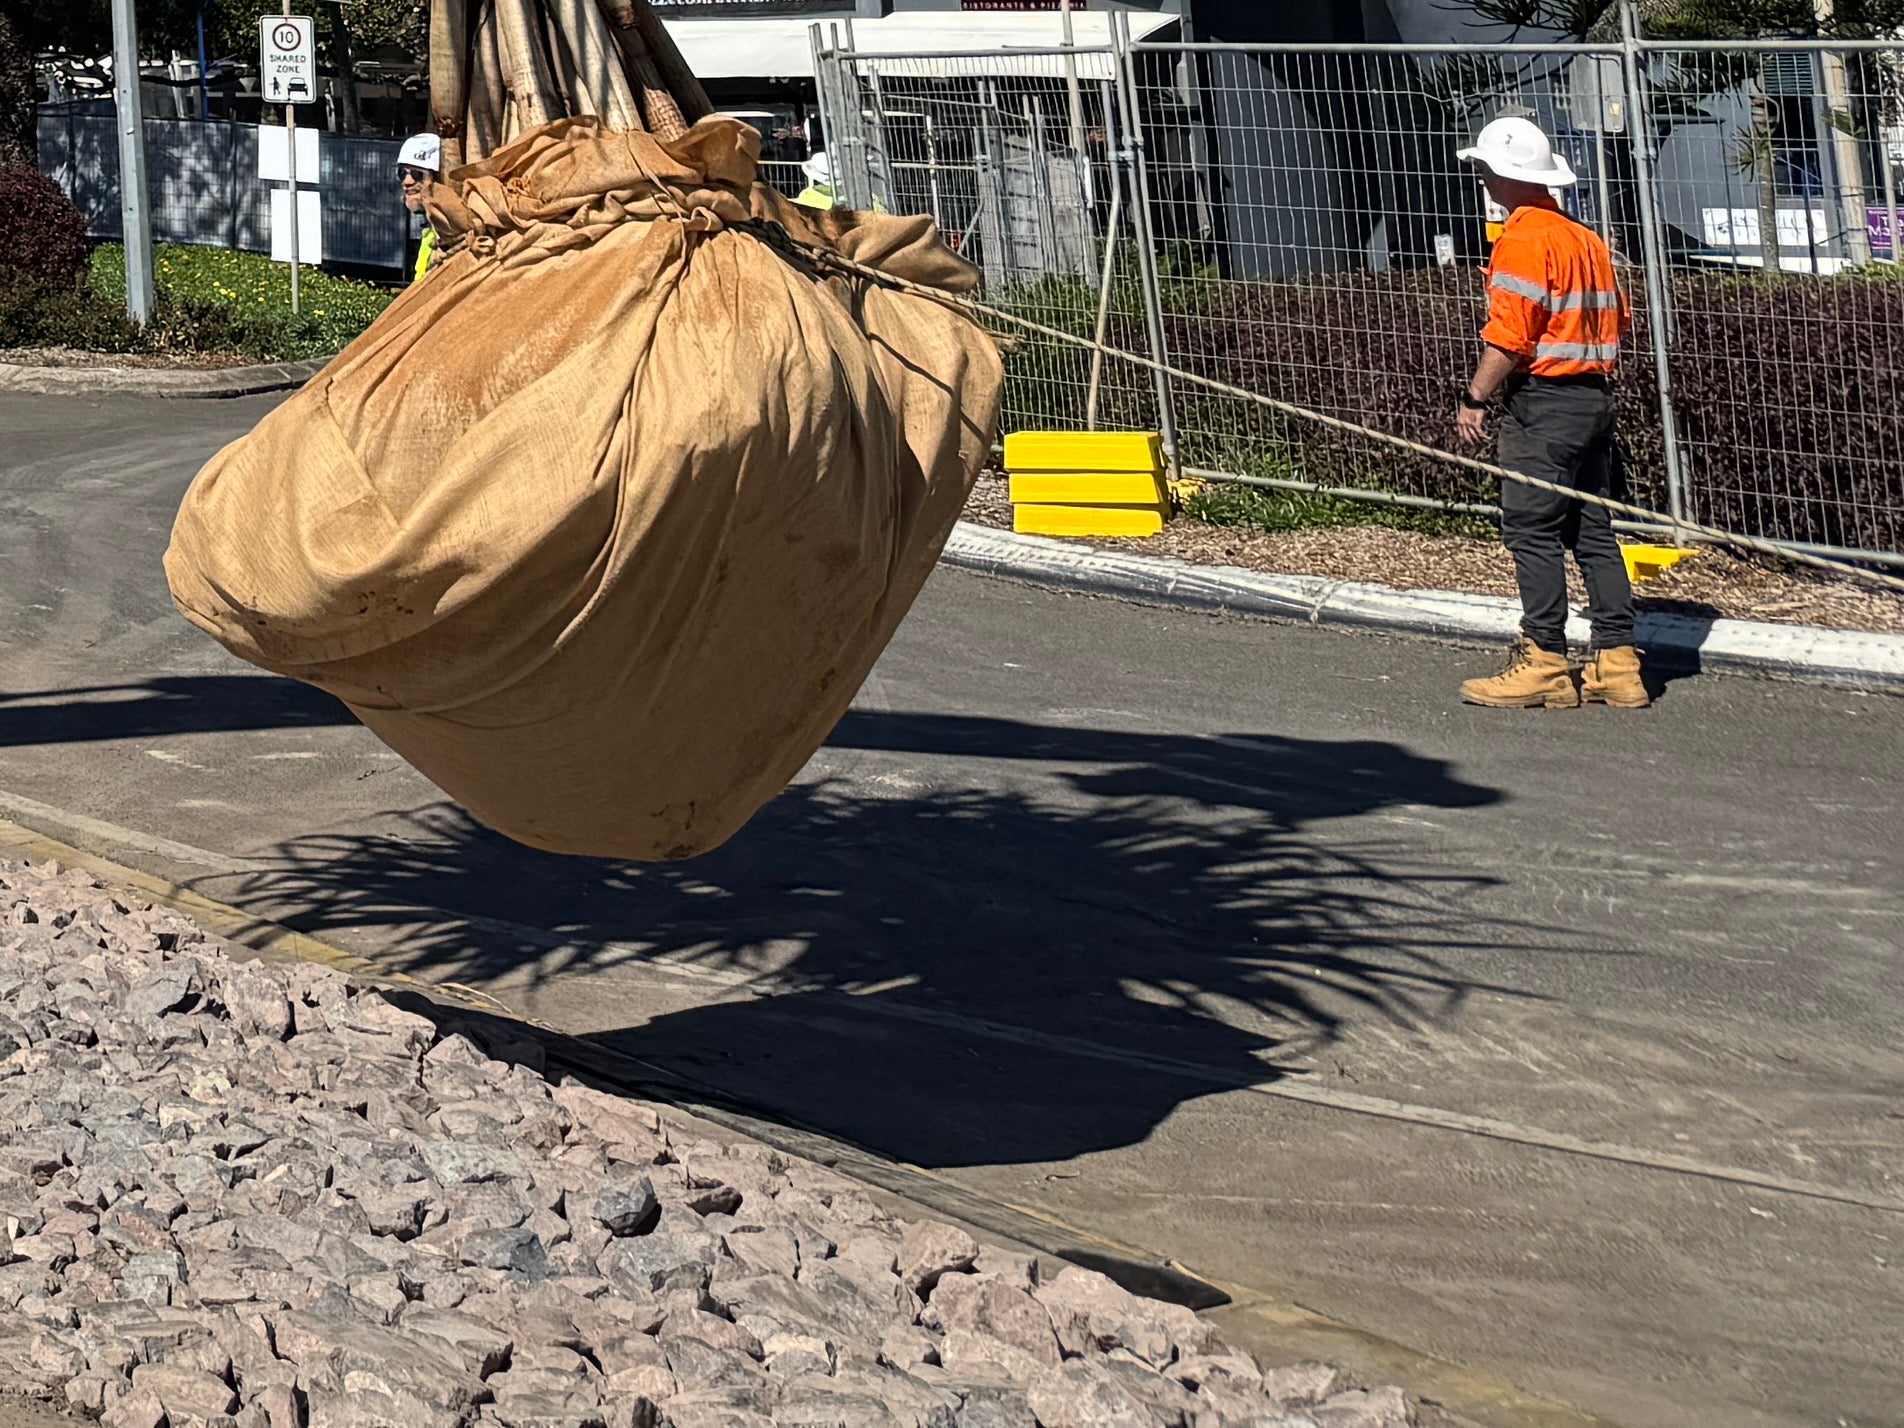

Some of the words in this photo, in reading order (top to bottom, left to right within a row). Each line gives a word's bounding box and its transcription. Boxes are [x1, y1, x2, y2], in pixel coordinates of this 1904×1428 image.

[279, 31, 295, 44] 10
[269, 54, 307, 64] SHARED
[276, 65, 301, 74] ZONE
